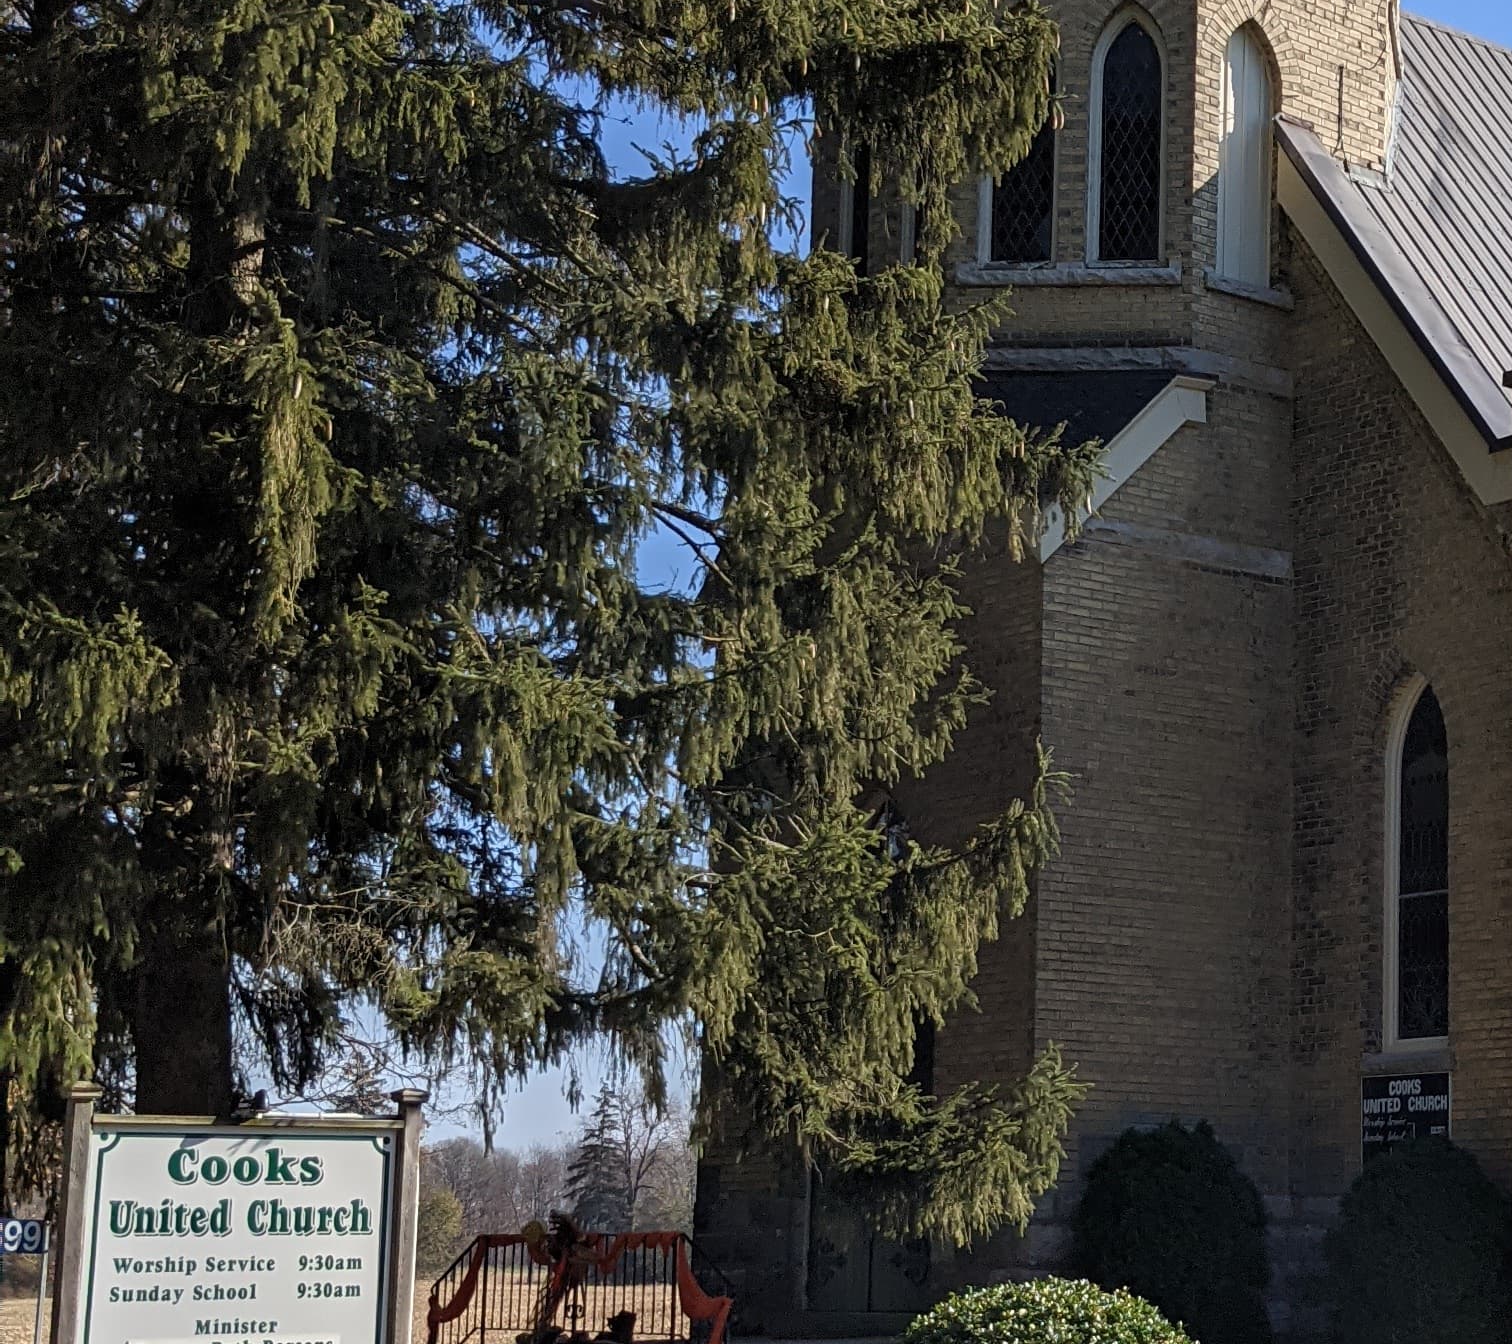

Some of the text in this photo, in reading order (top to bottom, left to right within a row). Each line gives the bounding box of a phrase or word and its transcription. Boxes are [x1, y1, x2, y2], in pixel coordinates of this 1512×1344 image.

[1389, 1079, 1421, 1095] COOKS
[1364, 1095, 1447, 1113] UNITED CHURCH
[168, 1147, 324, 1186] Cooks
[109, 1198, 373, 1237] United Church
[0, 1220, 42, 1252] 99
[112, 1255, 363, 1276] Worship Service 9:30am
[109, 1282, 361, 1305] Sunday School 9:30am
[194, 1318, 278, 1336] Minister
